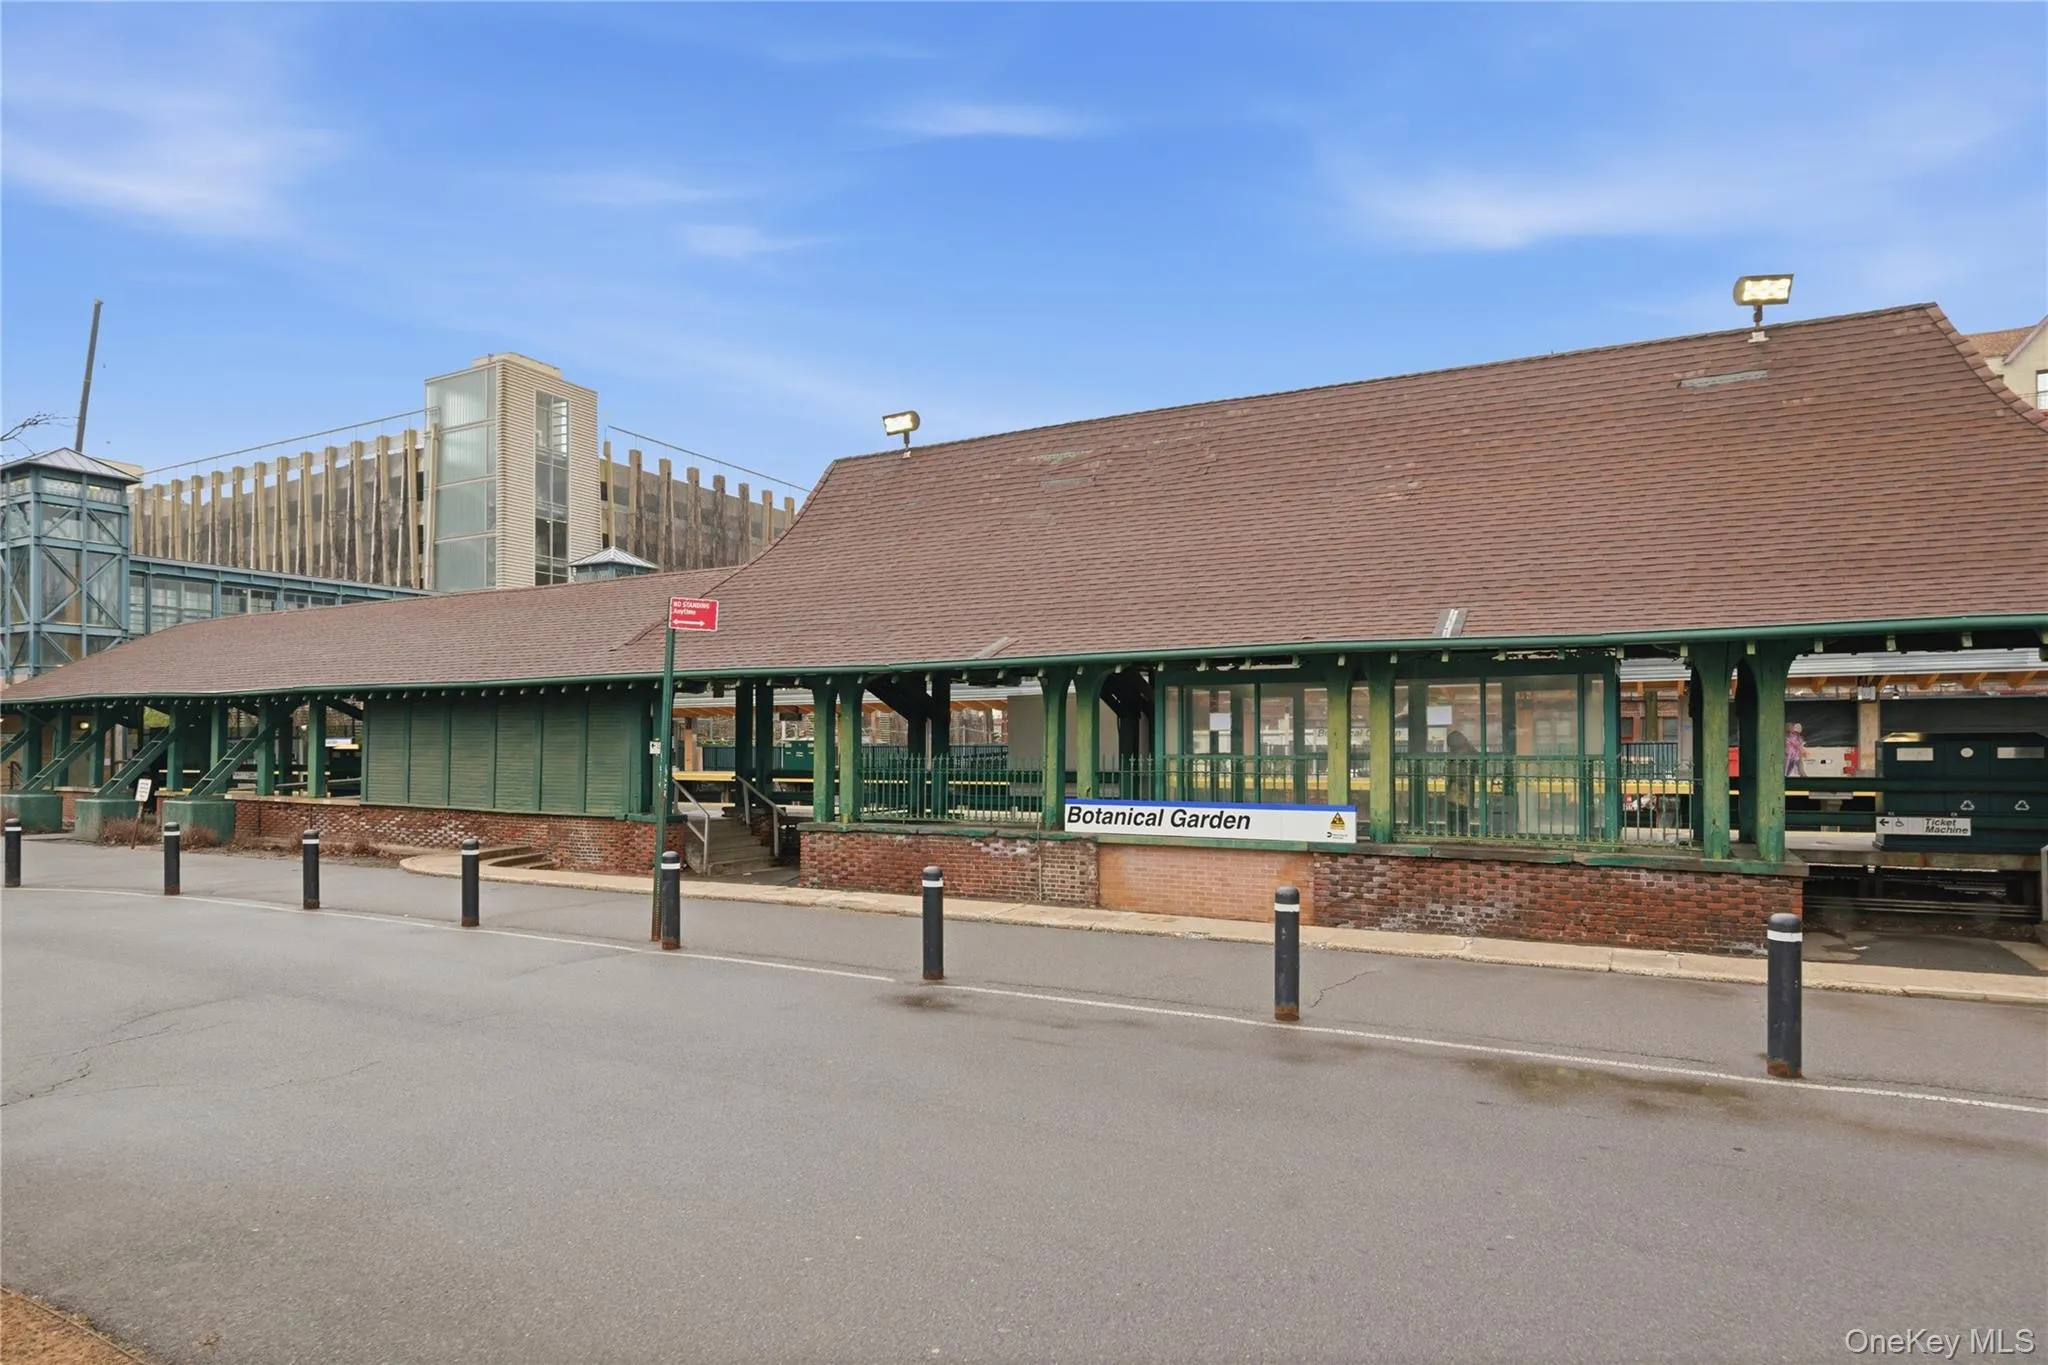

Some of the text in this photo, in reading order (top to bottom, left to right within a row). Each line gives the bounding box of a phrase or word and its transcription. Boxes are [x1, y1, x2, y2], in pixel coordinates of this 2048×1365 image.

[1067, 806, 1251, 830] Botanical Garden
[1925, 818, 1956, 826] Ticket
[1925, 826, 1969, 834] Machine
